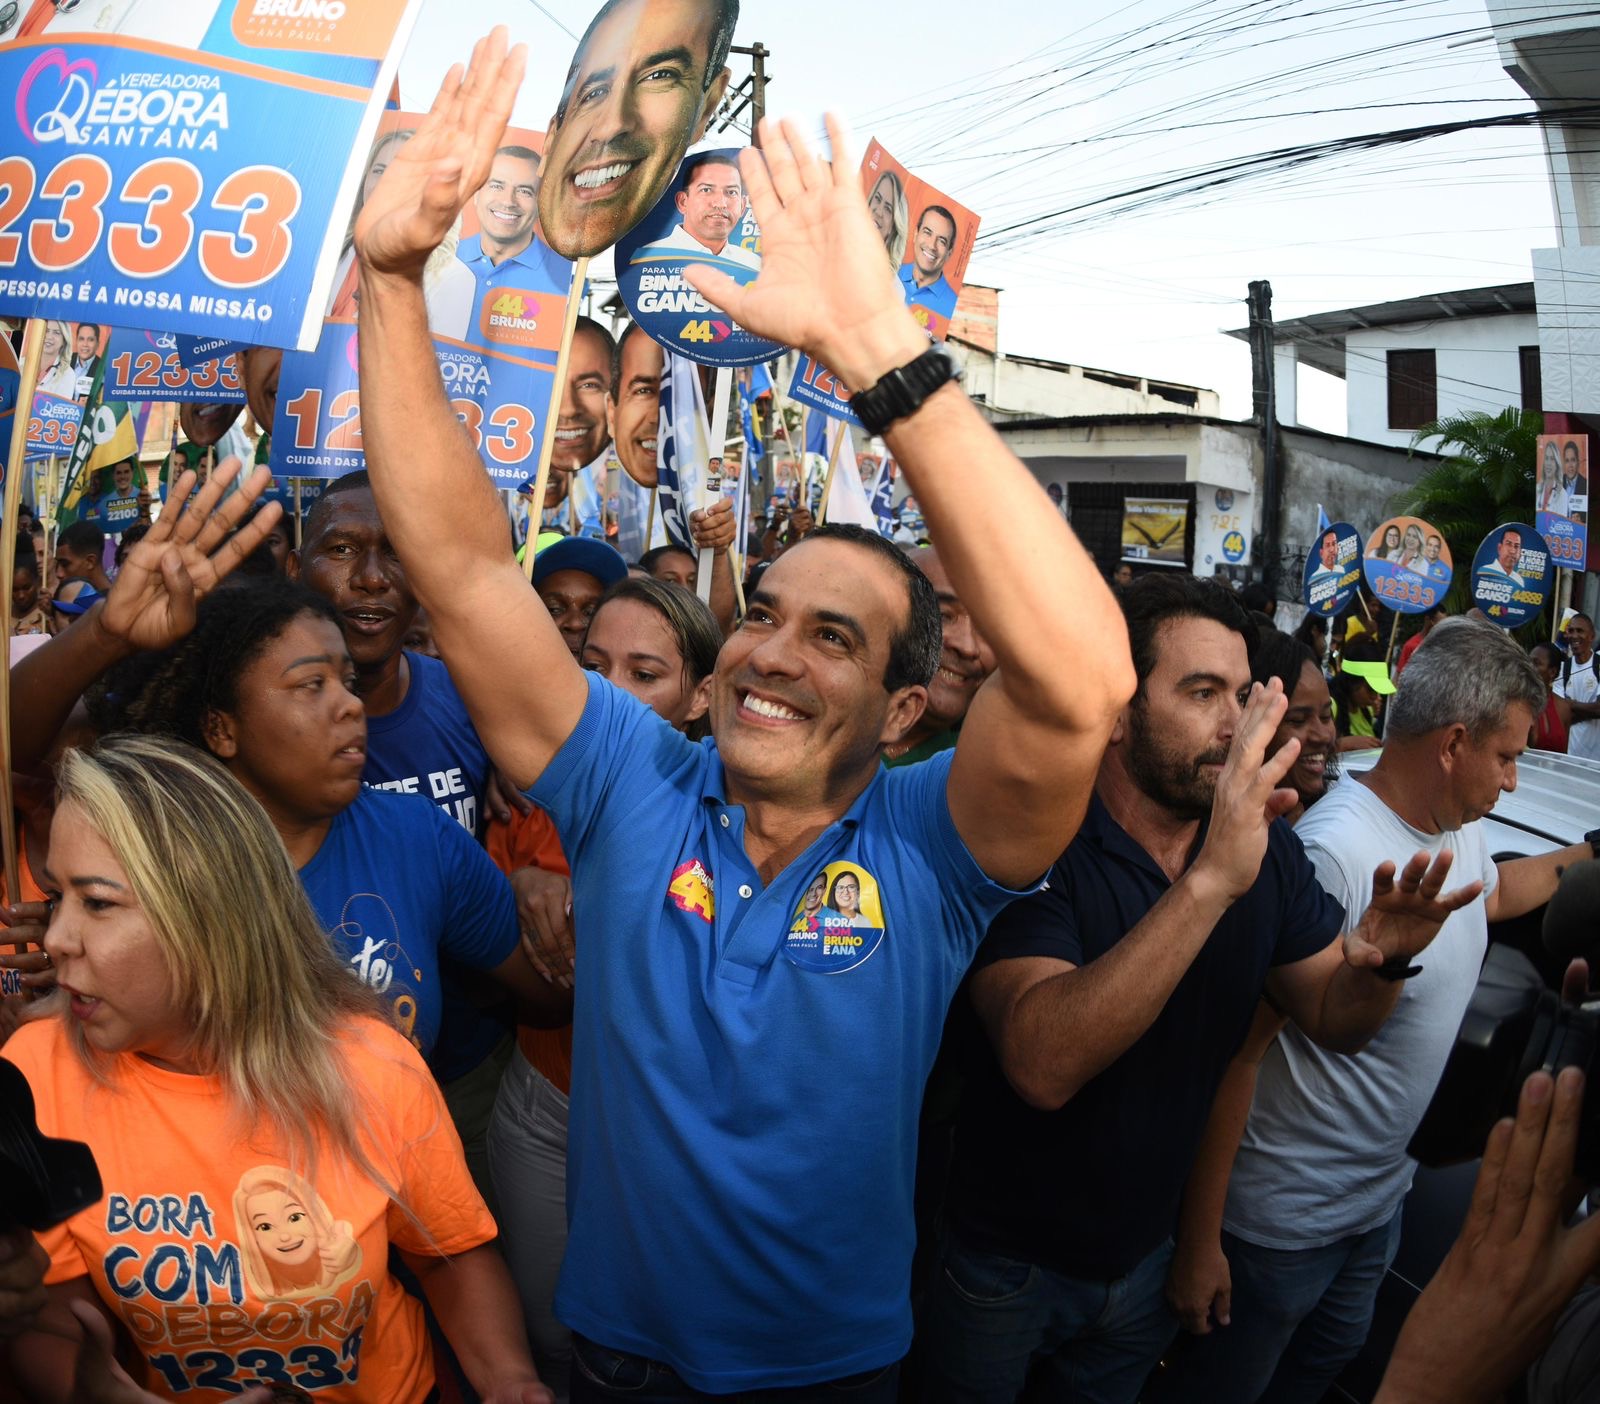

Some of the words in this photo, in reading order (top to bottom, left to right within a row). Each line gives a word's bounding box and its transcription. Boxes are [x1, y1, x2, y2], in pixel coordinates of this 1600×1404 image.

[252, 0, 346, 21] BRUNO
[248, 17, 337, 31] PREFEITO
[120, 73, 221, 90] VEREADORA
[79, 125, 218, 151] SANTANA
[642, 267, 666, 275] PARA
[0, 279, 73, 300] PESSOAS
[77, 280, 91, 299] É
[95, 286, 107, 303] A
[115, 287, 182, 312] NOSSA
[189, 295, 273, 322] MISSÃO
[492, 293, 524, 318] 44
[489, 314, 537, 331] BRUNO
[680, 319, 714, 344] 44
[193, 339, 232, 355] CUIDA
[436, 351, 482, 364] READORA
[440, 361, 492, 385] ORA
[286, 455, 330, 466] CUIDAR
[334, 456, 358, 467] DAS
[286, 486, 321, 498] 2100
[107, 508, 139, 521] 22100
[1223, 534, 1244, 553] 44
[1521, 548, 1547, 560] CHEGOU
[1374, 575, 1436, 607] 12333
[1475, 588, 1511, 604] GANSO
[428, 767, 466, 799] DE
[824, 917, 856, 928] BORA
[787, 931, 819, 940] BRUNO
[823, 927, 851, 936] COM
[823, 935, 863, 947] BRUNO
[822, 944, 831, 955] E
[831, 945, 856, 955] ANA
[106, 1192, 216, 1238] BORA
[103, 1240, 245, 1305] COM
[117, 1280, 377, 1346] DEBORA
